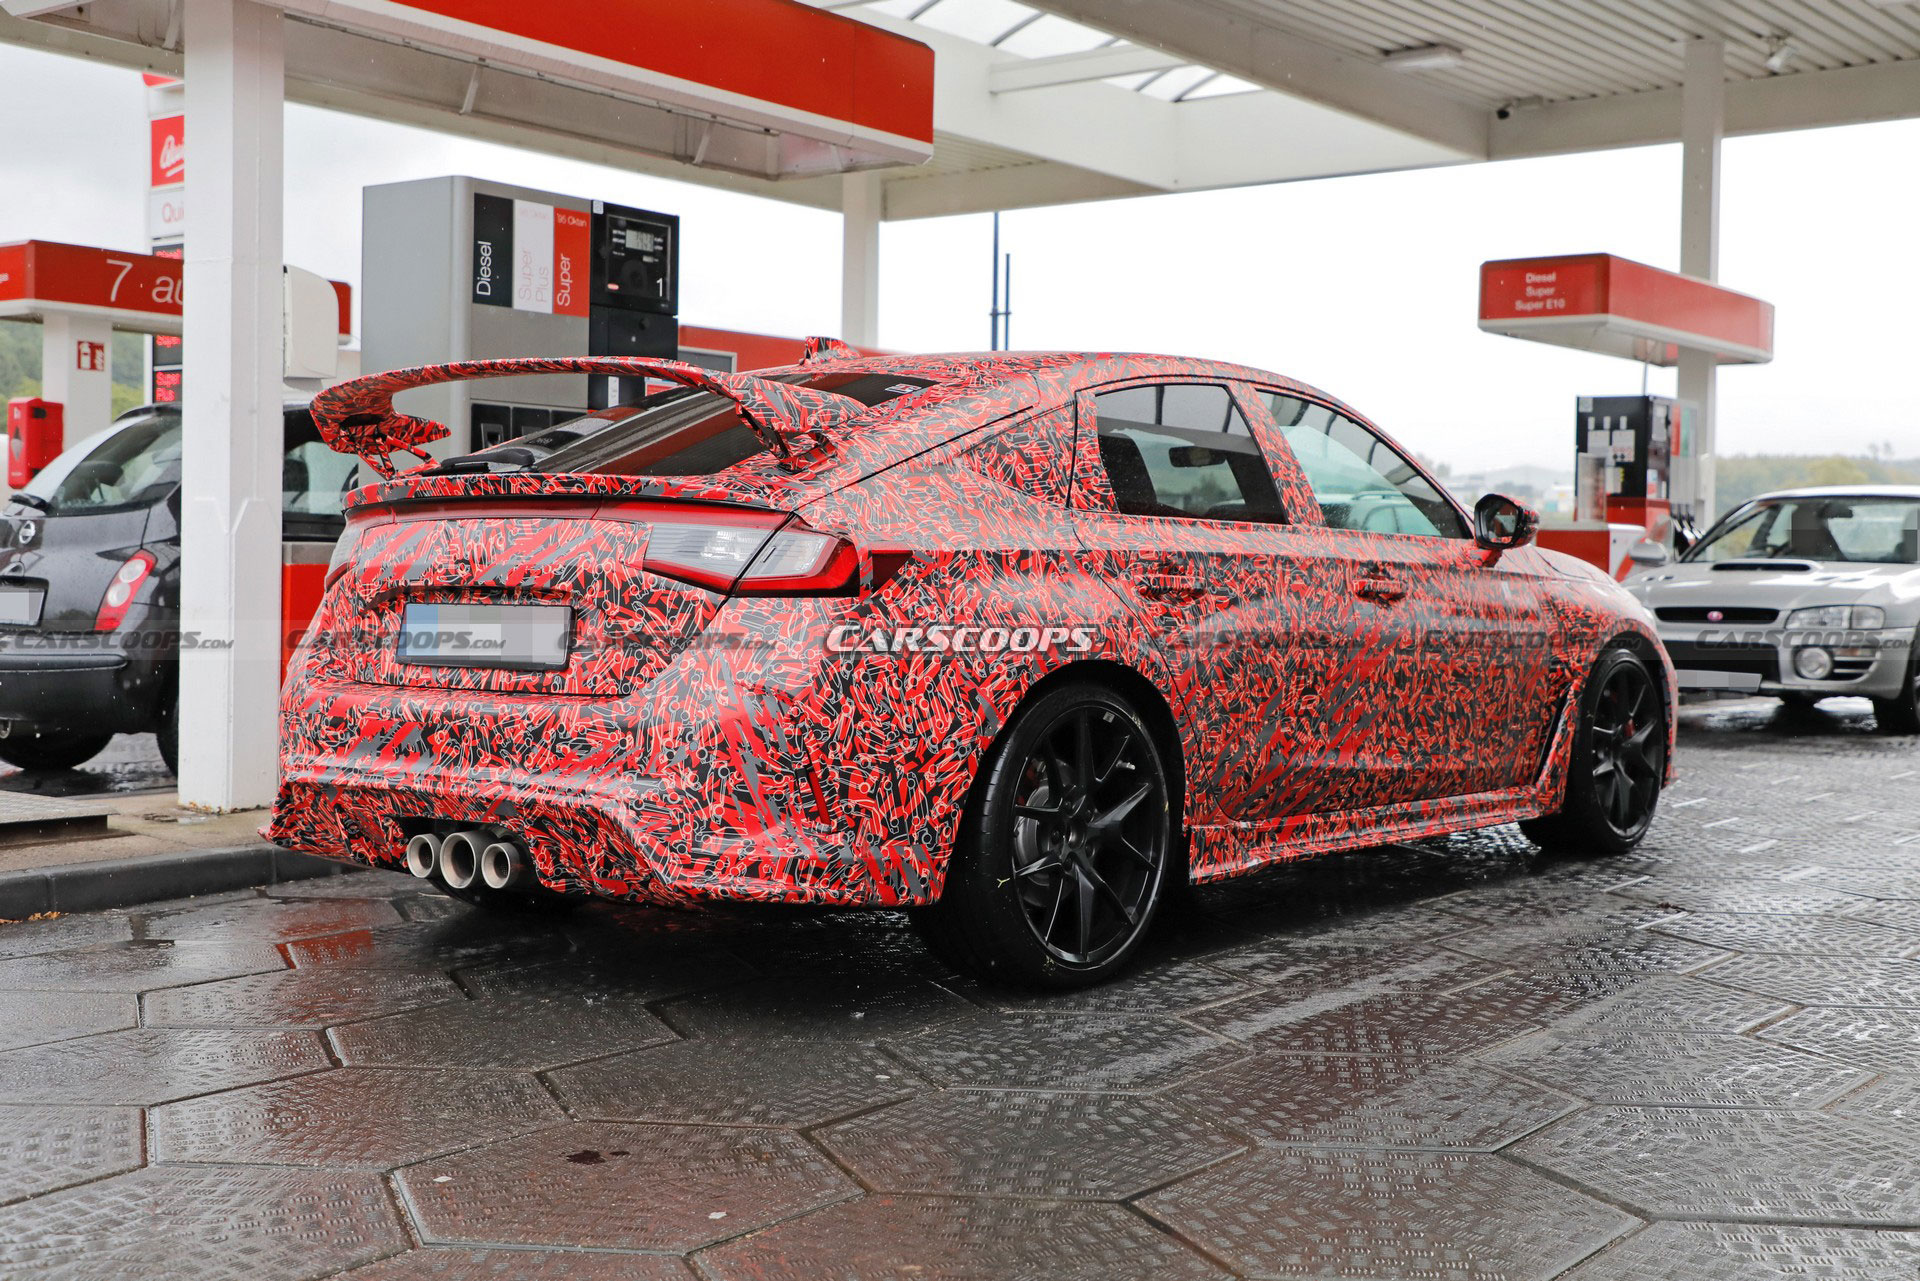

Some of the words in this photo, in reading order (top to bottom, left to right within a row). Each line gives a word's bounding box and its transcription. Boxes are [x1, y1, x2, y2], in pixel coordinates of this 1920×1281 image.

[476, 240, 492, 296] Diesel
[518, 249, 534, 301] Super
[1525, 271, 1557, 283] Diesel
[106, 258, 133, 302] 7
[535, 265, 550, 303] Plus
[556, 252, 573, 307] Super
[656, 277, 663, 297] 1
[1525, 286, 1555, 298] Super
[1514, 300, 1544, 313] Super
[1546, 298, 1566, 309] E10
[156, 371, 182, 388] Super
[156, 388, 176, 402] Plus
